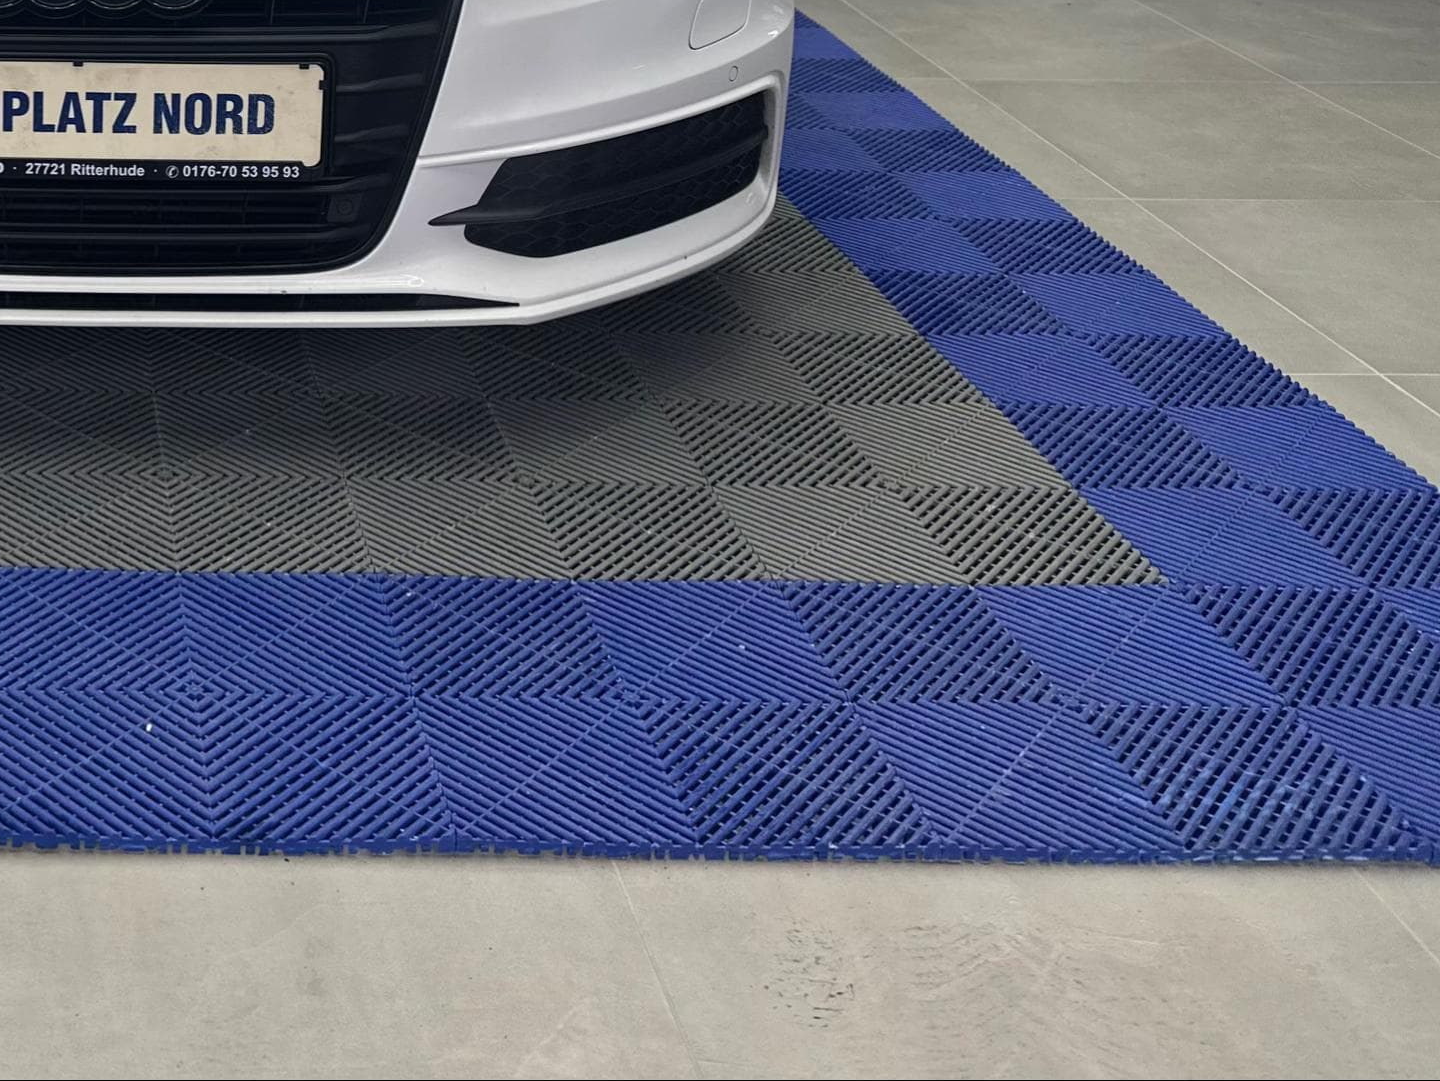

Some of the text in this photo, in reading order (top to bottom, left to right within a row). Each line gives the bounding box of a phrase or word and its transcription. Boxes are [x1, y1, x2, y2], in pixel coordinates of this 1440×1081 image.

[153, 92, 276, 135] NORD
[25, 162, 65, 175] 27721
[71, 163, 145, 176] Ritterhude
[182, 165, 237, 178] 0176-70
[241, 165, 258, 178] 53
[262, 166, 279, 178] 95
[283, 166, 300, 179] 93
